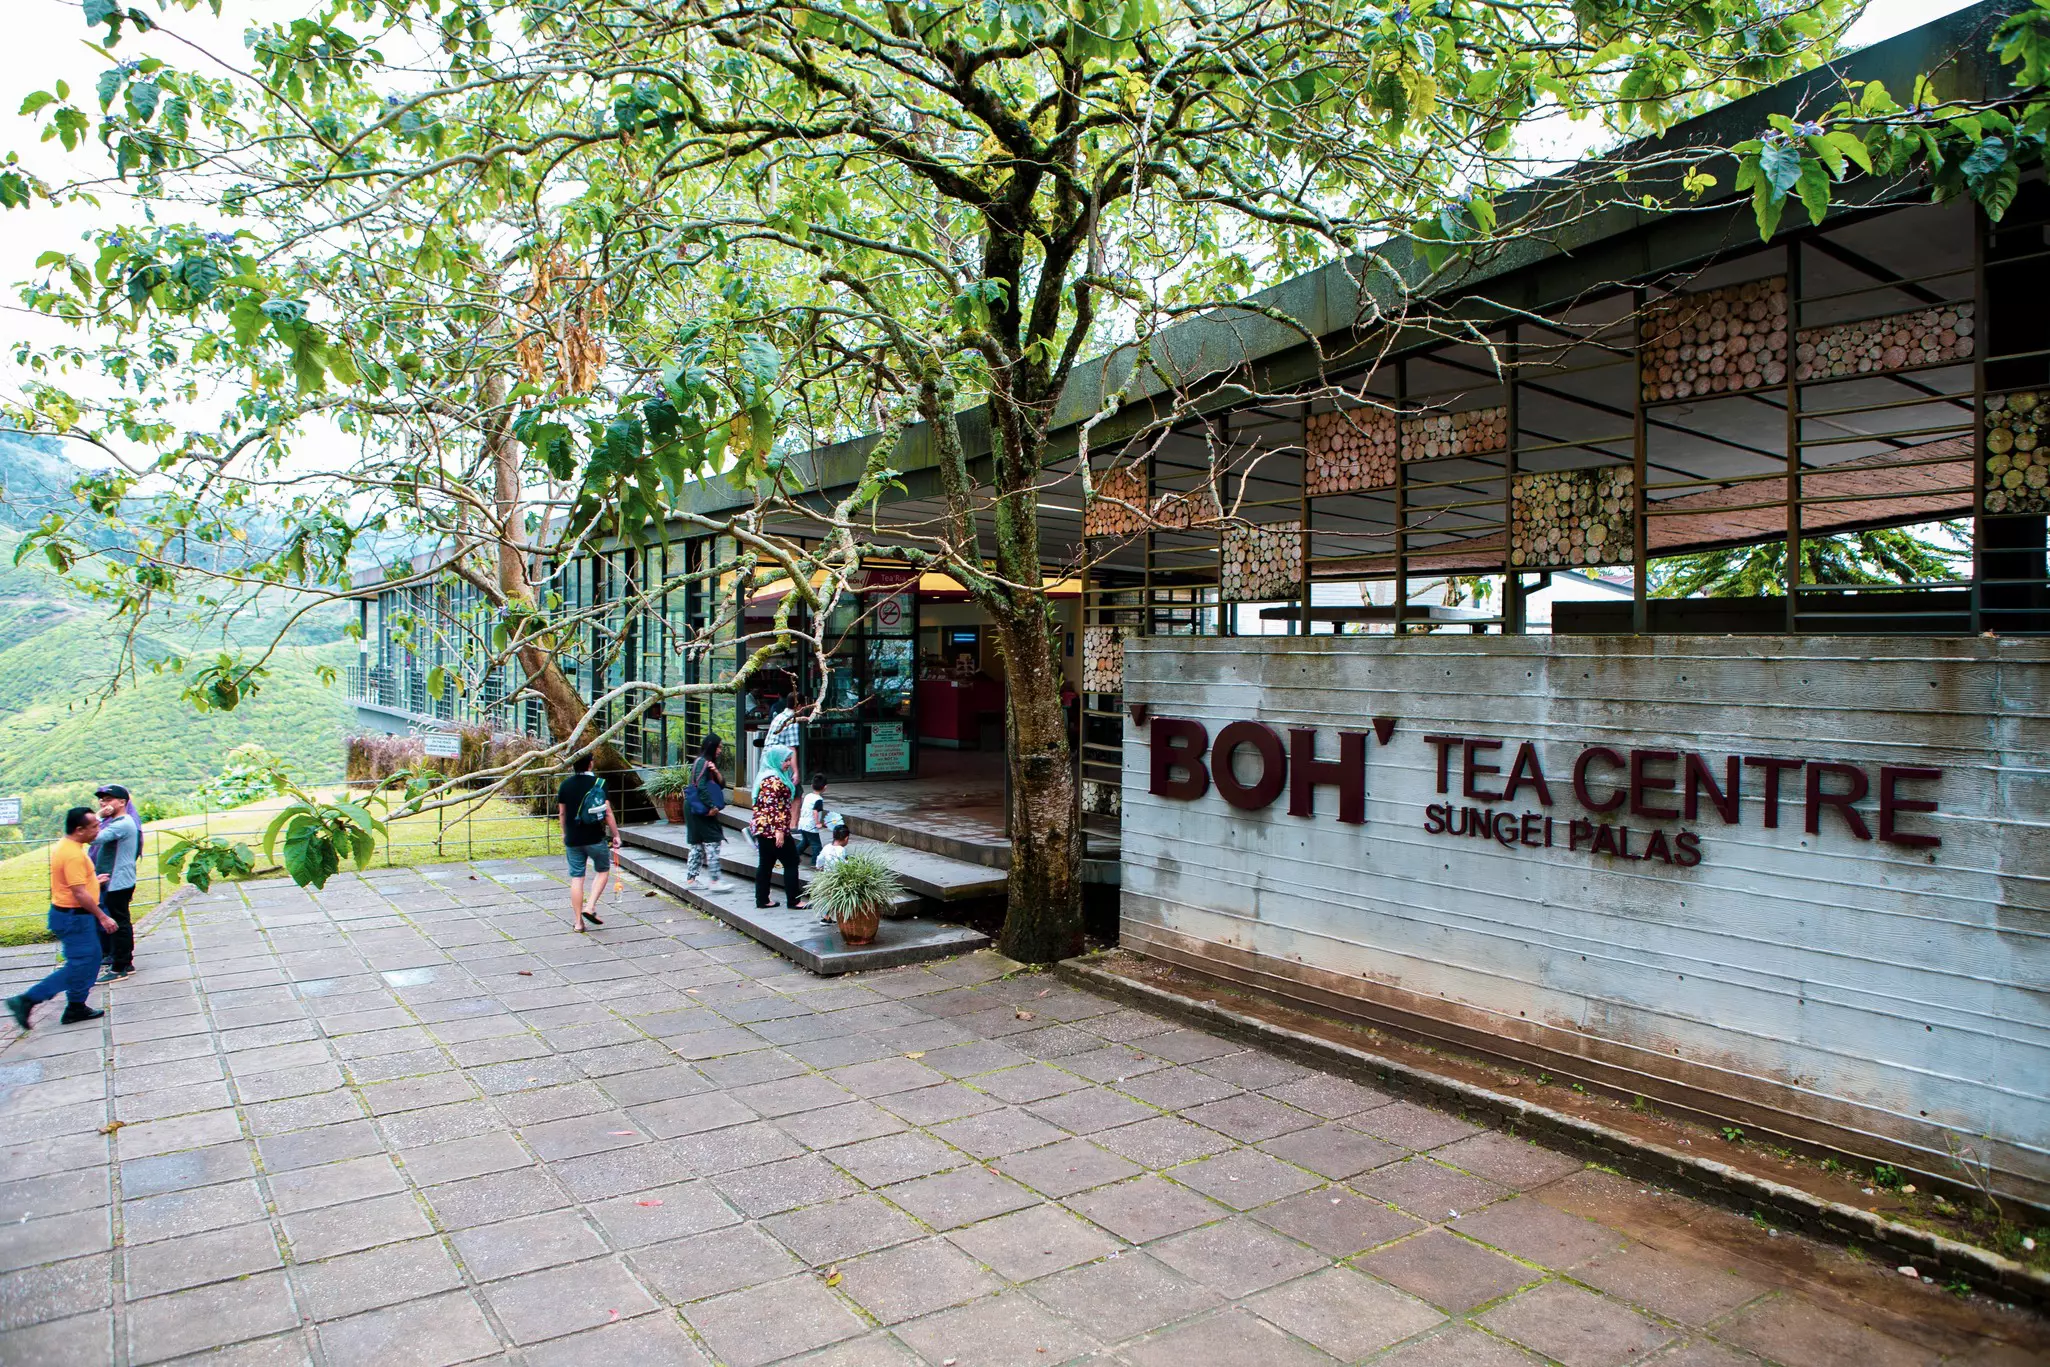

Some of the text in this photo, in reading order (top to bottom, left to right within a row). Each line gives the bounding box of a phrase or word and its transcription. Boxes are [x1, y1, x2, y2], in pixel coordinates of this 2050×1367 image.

[1424, 736, 1553, 806] TEA
[1573, 747, 1942, 847] CENTRE
[1424, 804, 1701, 867] SUNGEI PALAS
